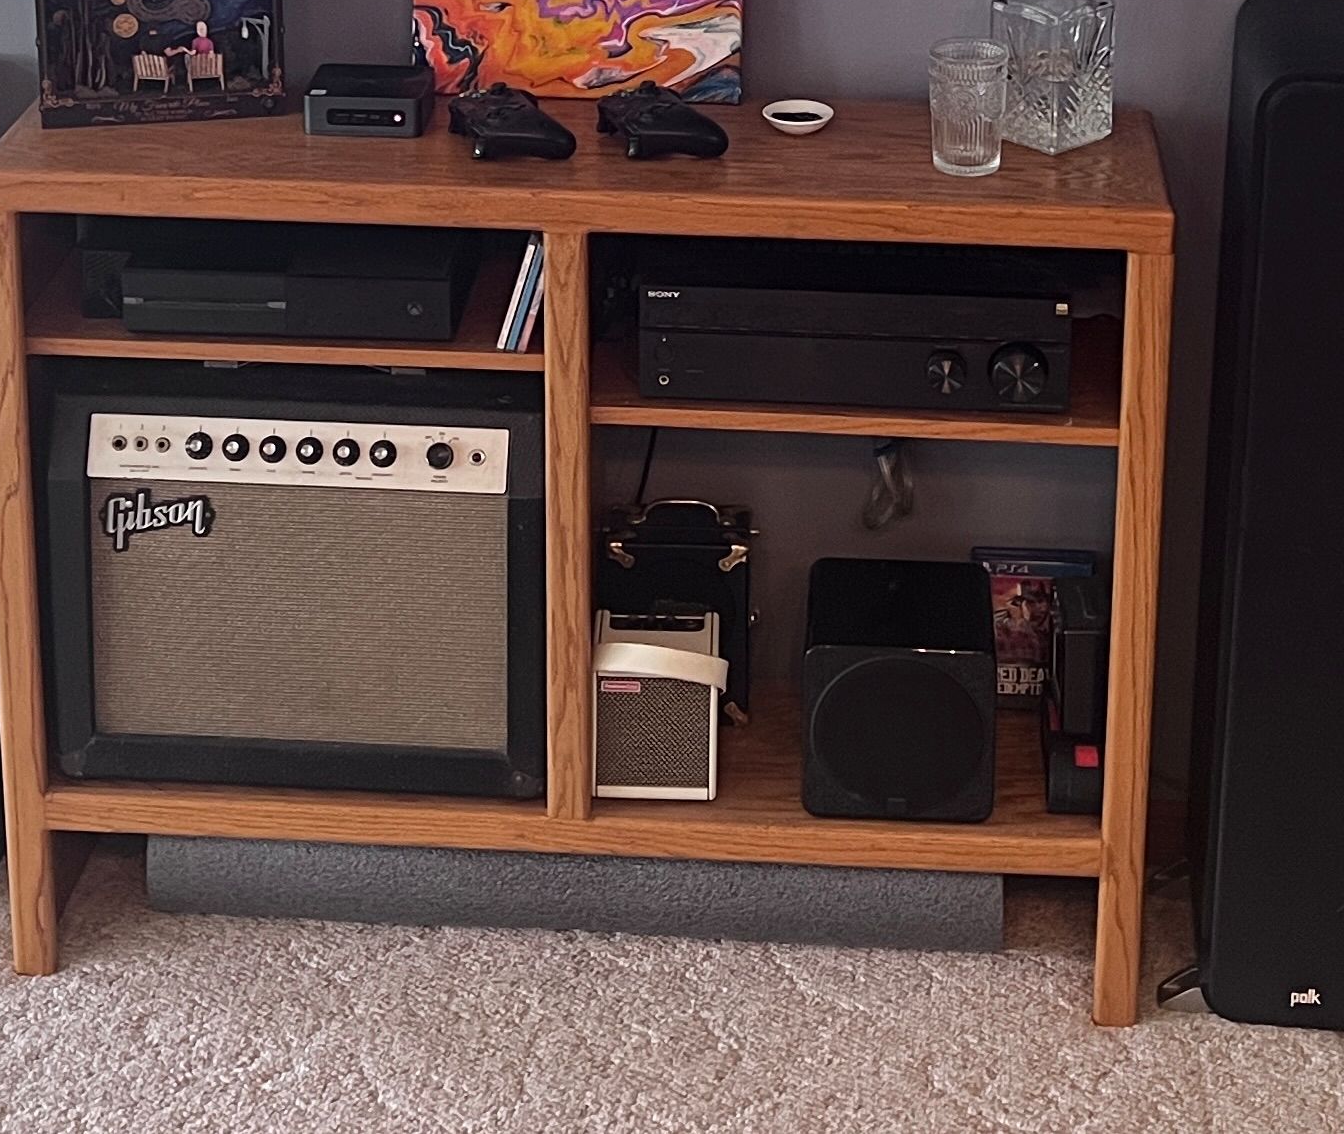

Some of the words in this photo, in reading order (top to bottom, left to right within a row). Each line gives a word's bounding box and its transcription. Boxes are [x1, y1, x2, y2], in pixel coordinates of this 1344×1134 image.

[106, 493, 206, 550] Gibson
[996, 564, 1029, 573] PS4
[1290, 988, 1321, 1007] polk
